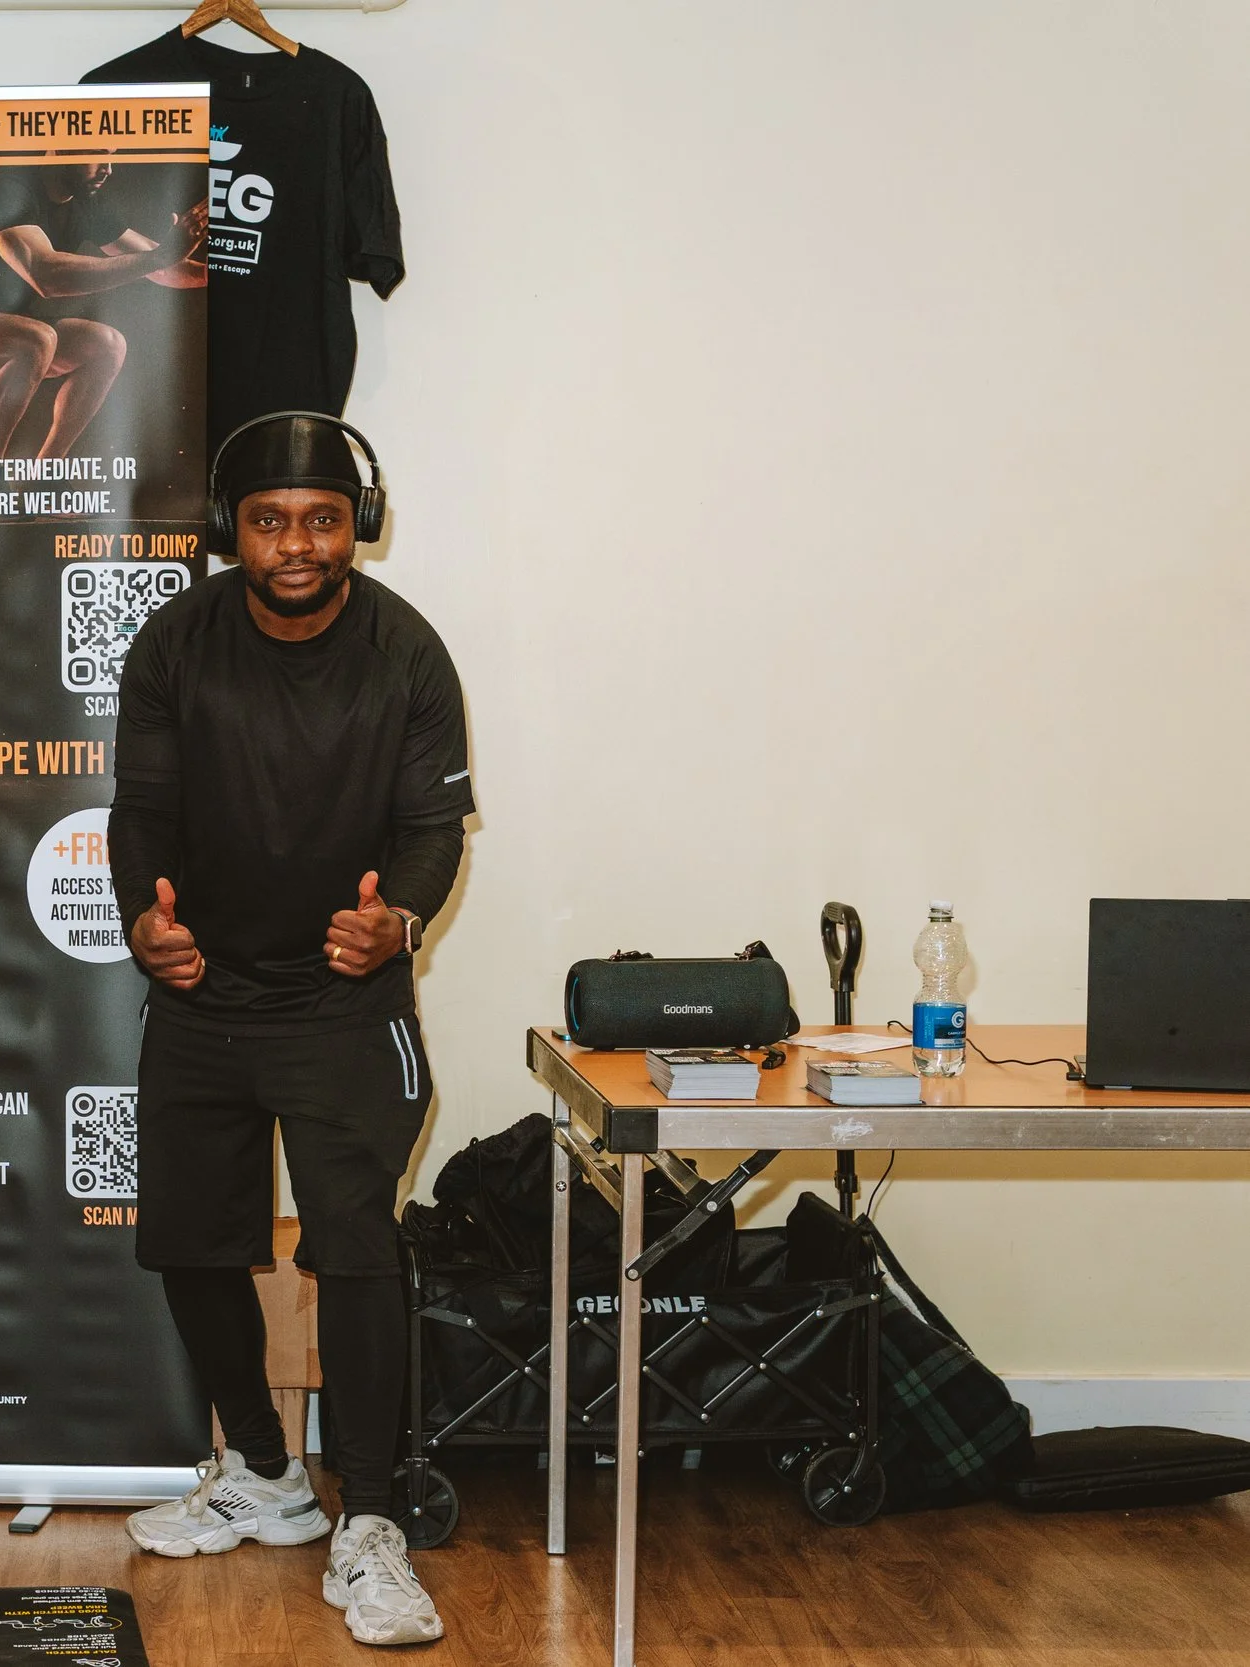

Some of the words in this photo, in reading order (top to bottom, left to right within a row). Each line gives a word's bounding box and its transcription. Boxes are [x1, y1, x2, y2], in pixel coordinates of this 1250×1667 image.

[7, 111, 92, 136] THEY'RE
[99, 110, 136, 135] ALL
[142, 109, 192, 134] FREE
[223, 264, 251, 275] Escape
[113, 457, 137, 480] OR
[24, 491, 116, 515] WELCOME.
[54, 535, 115, 558] READY
[120, 535, 144, 557] TO
[149, 535, 198, 558] JOIN?
[84, 696, 119, 716] SCA
[36, 742, 104, 775] WITH
[53, 832, 110, 865] +FR
[51, 878, 103, 895] ACCESS
[664, 1004, 713, 1016] Goodmans
[83, 1206, 122, 1225] SCAN
[127, 1206, 138, 1226] M
